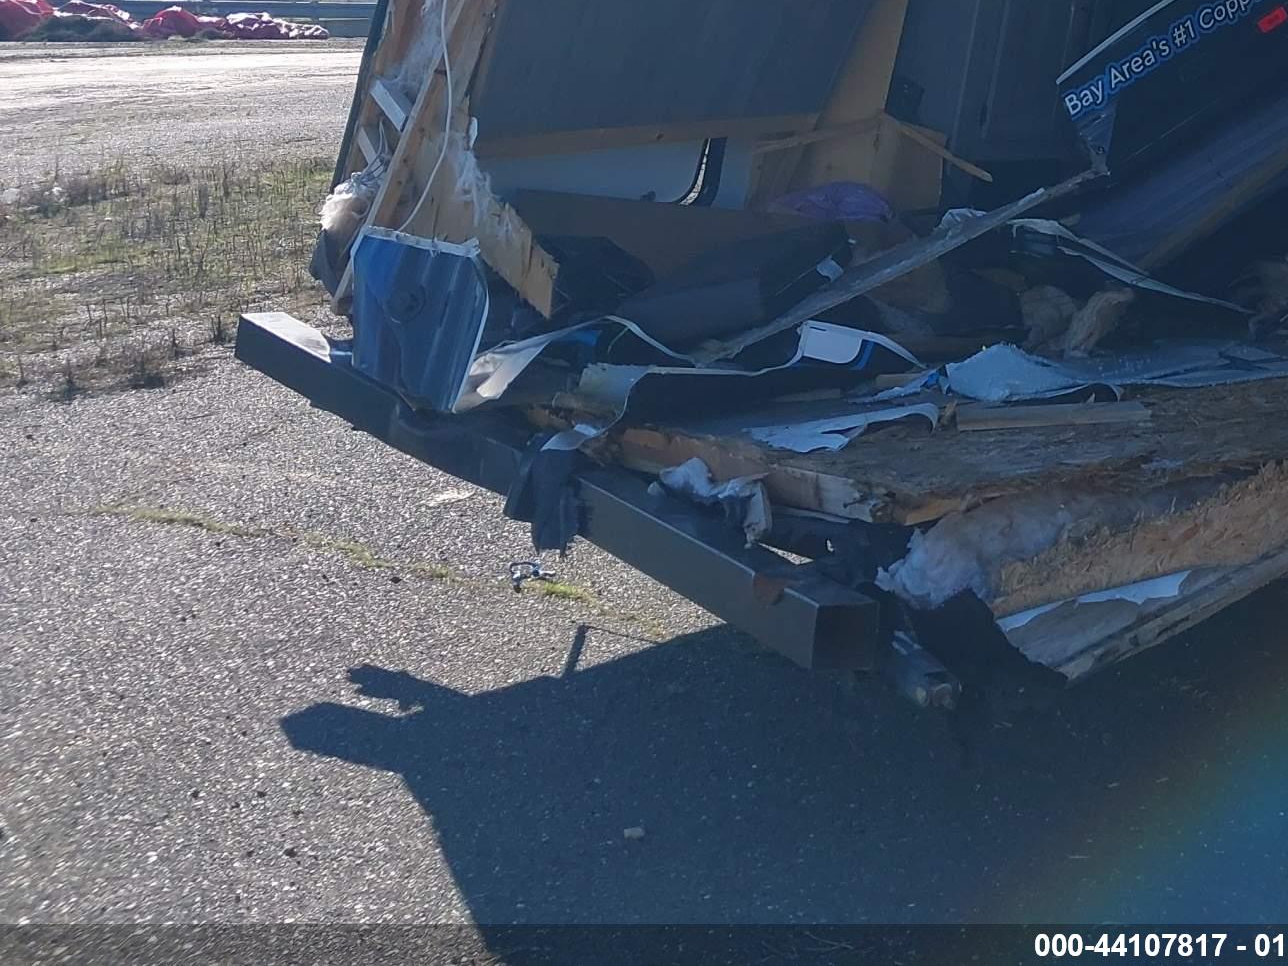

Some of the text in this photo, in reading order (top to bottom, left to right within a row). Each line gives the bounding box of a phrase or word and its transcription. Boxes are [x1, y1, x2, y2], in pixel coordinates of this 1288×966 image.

[1064, 80, 1103, 116] Bay
[1110, 39, 1170, 89] Area's
[1172, 19, 1195, 48] #1
